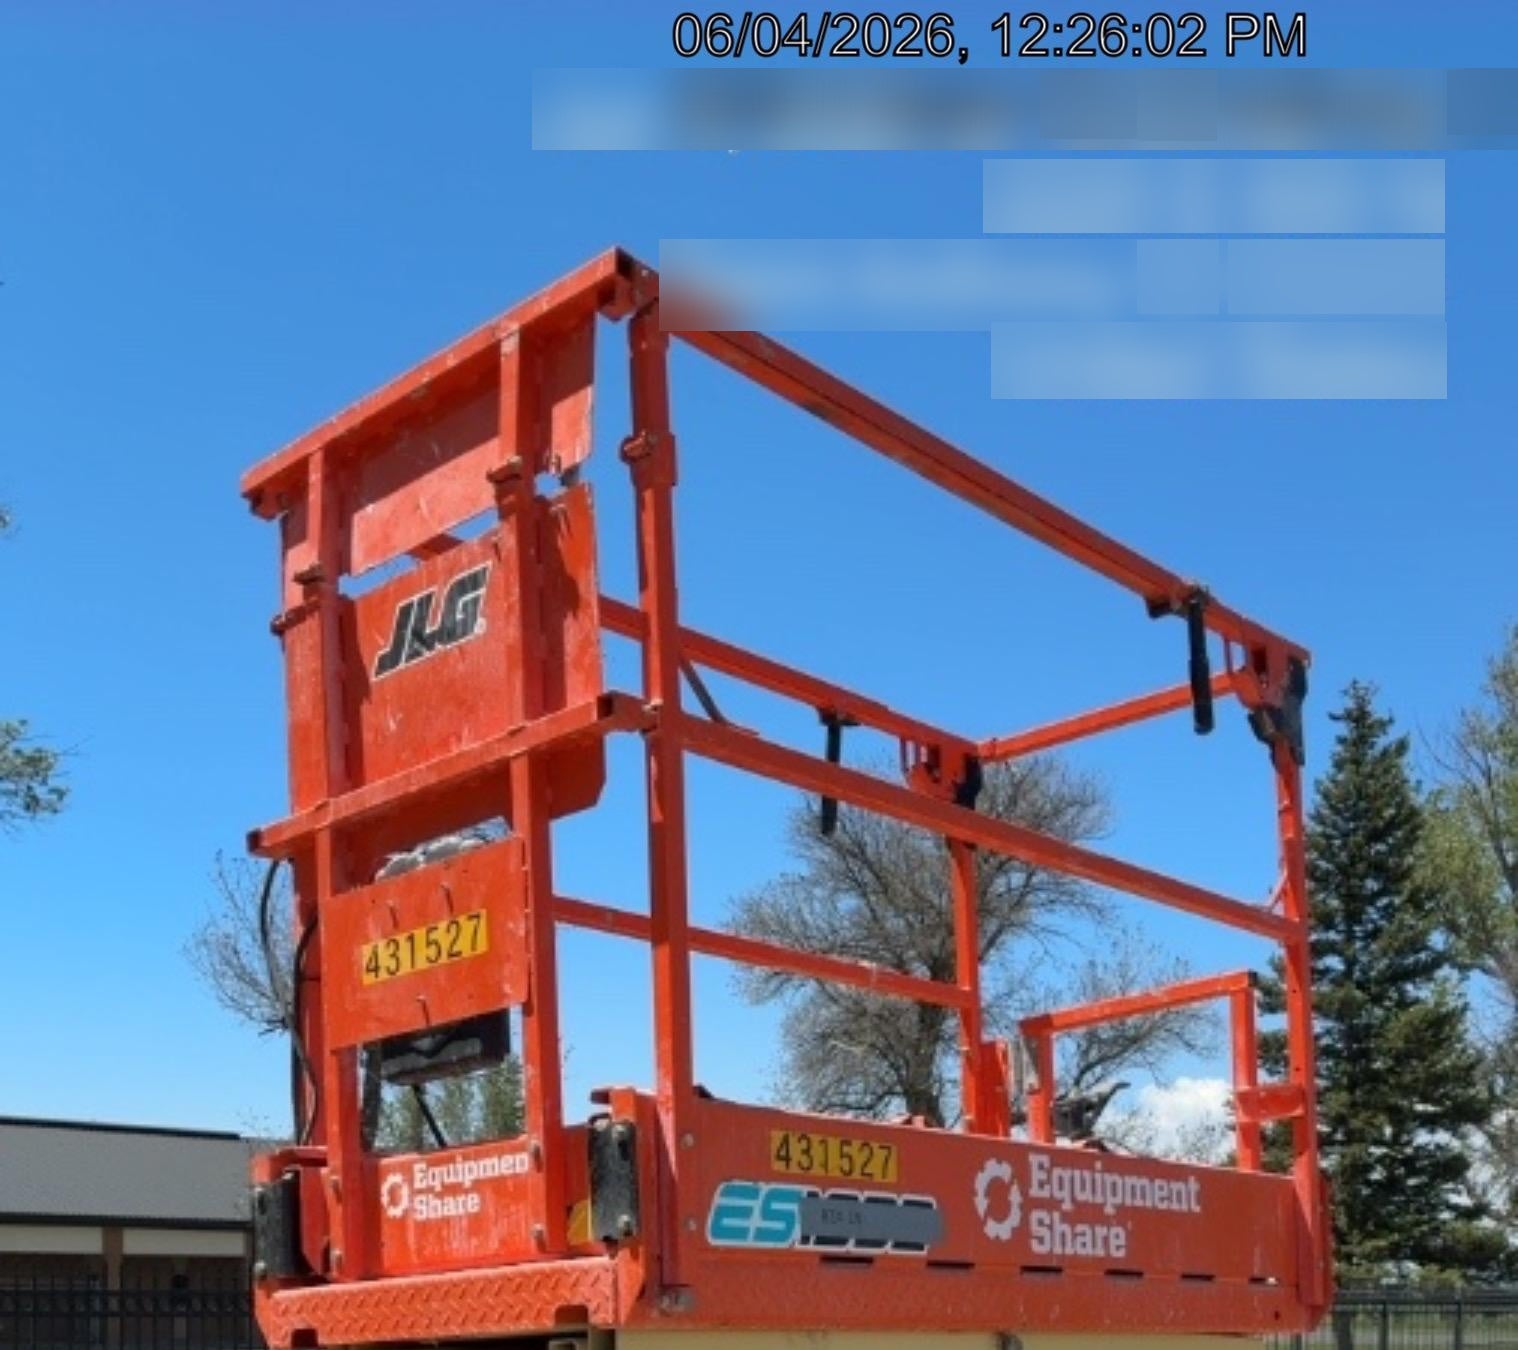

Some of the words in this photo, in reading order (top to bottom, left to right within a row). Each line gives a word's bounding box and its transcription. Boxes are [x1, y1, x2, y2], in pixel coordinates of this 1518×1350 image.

[371, 560, 492, 682] JLG
[365, 912, 482, 979] 431527
[412, 1152, 529, 1191] Equipmen
[775, 1132, 893, 1179] 431527
[413, 1192, 481, 1221] Share
[1028, 1153, 1201, 1214] Equipment
[1029, 1209, 1127, 1258] Share
